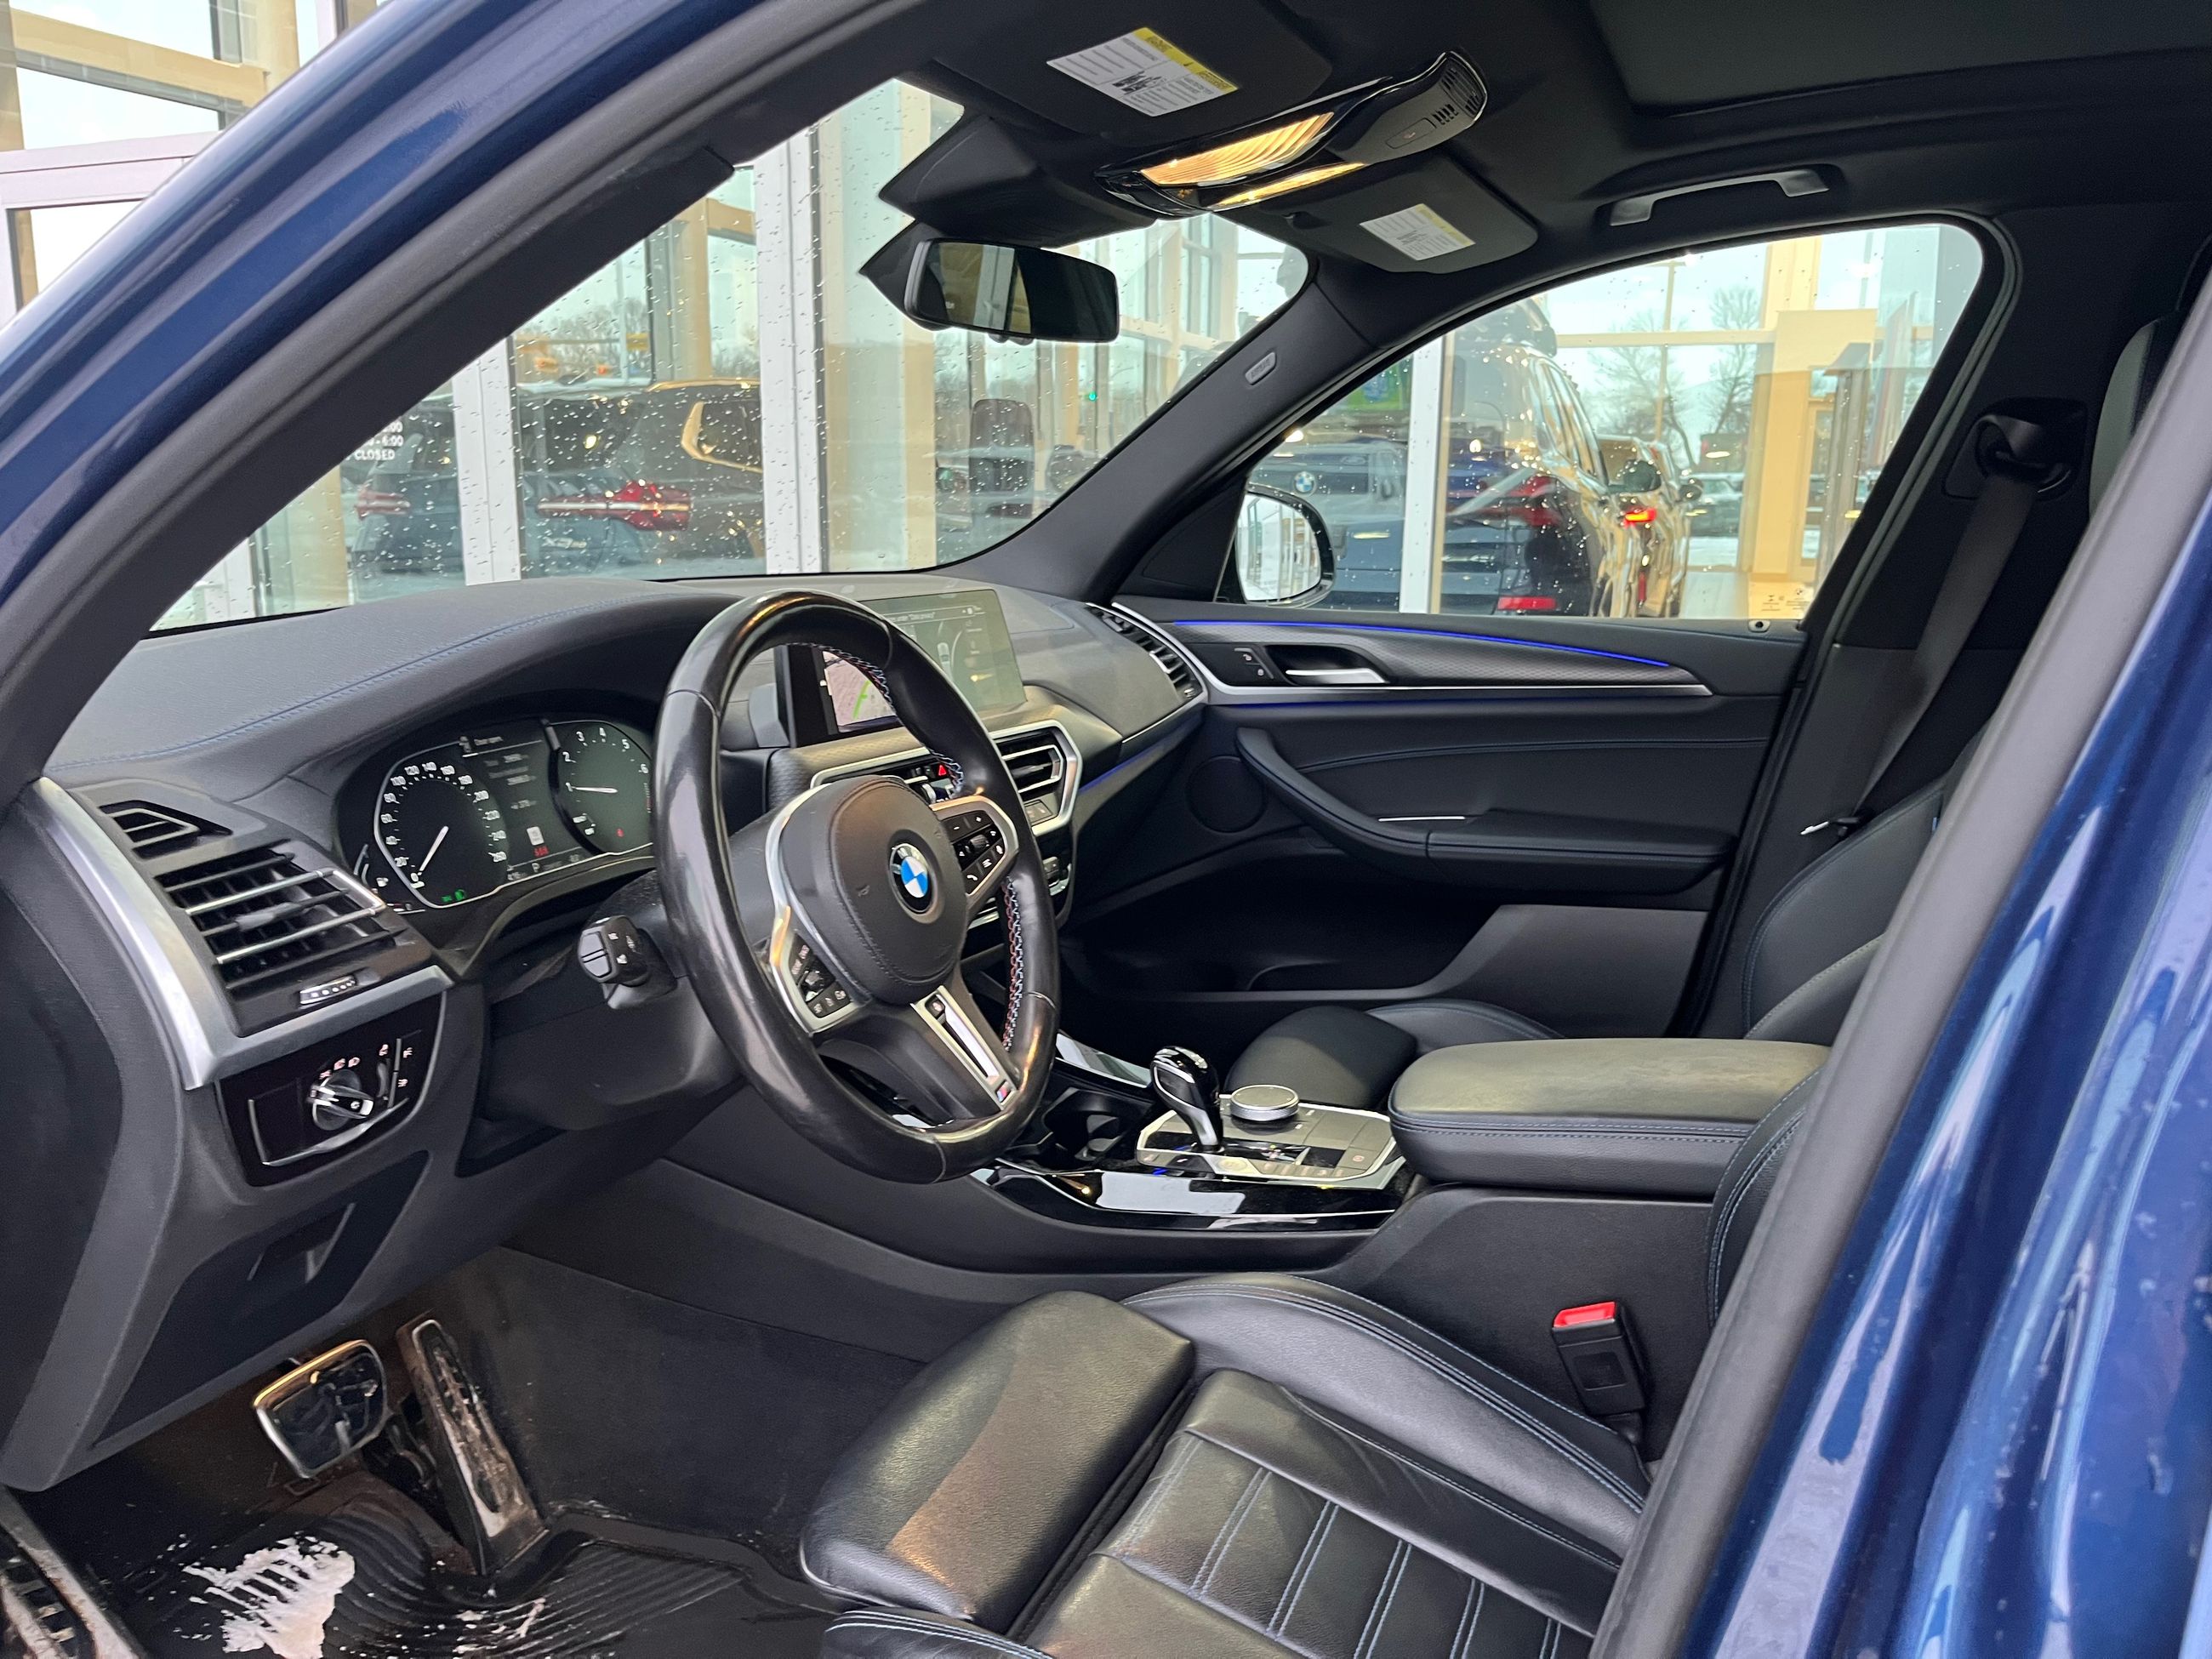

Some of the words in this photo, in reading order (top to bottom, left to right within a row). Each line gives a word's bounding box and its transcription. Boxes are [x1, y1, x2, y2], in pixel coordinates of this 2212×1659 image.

[354, 448, 396, 461] CLOSED
[576, 731, 584, 742] 3
[621, 738, 630, 750] 5
[562, 751, 571, 762] 2
